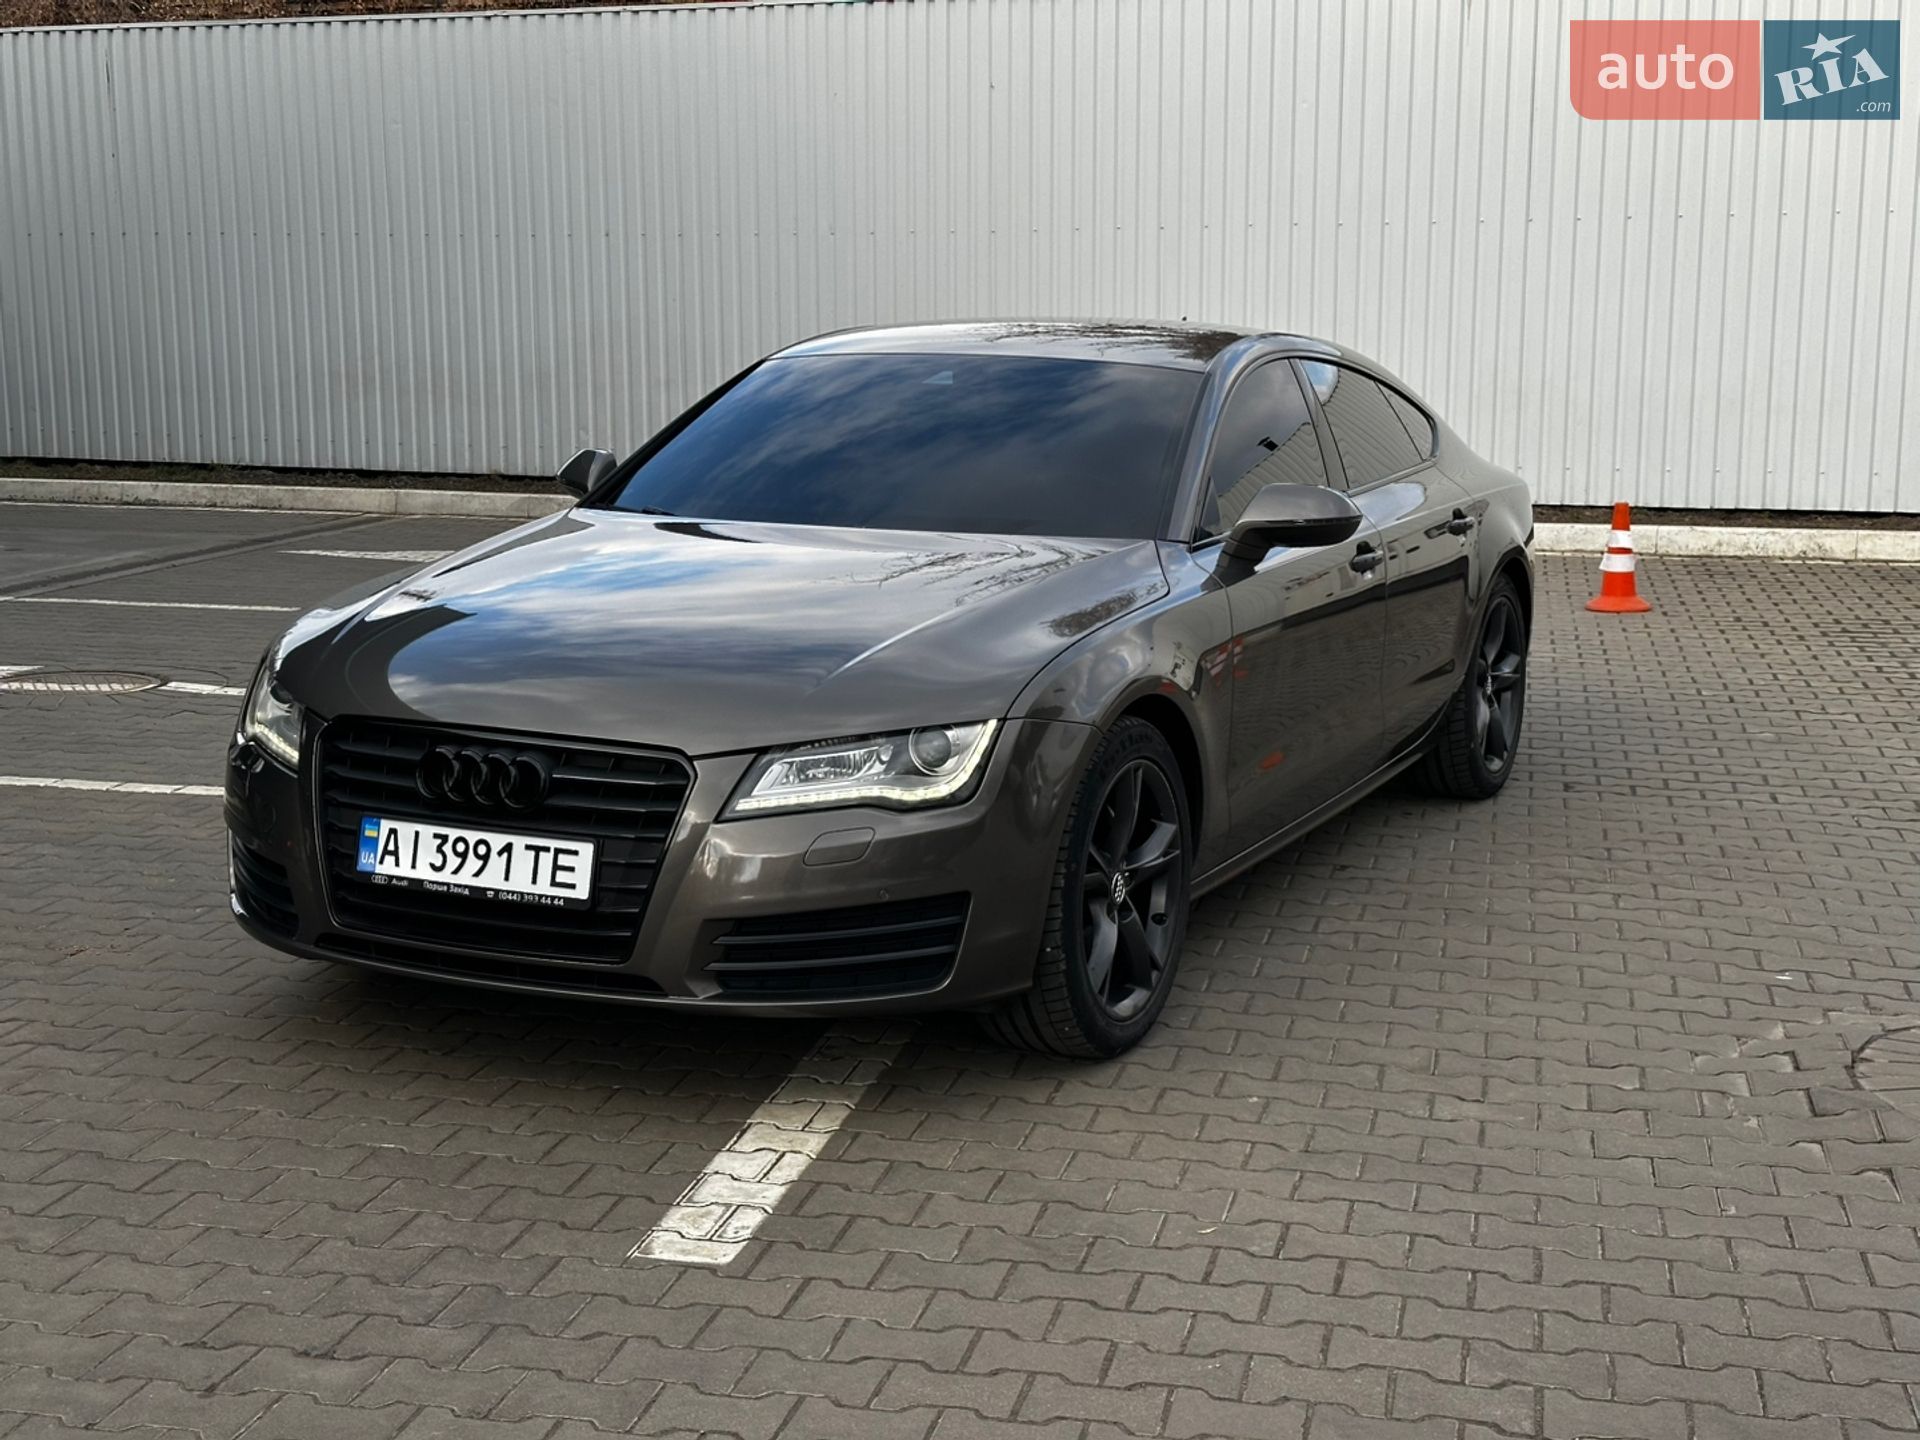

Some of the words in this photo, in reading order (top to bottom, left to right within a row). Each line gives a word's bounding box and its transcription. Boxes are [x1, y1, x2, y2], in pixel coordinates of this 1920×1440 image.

[361, 851, 375, 865] UA
[391, 877, 409, 887] Audi
[498, 891, 521, 902] (044)
